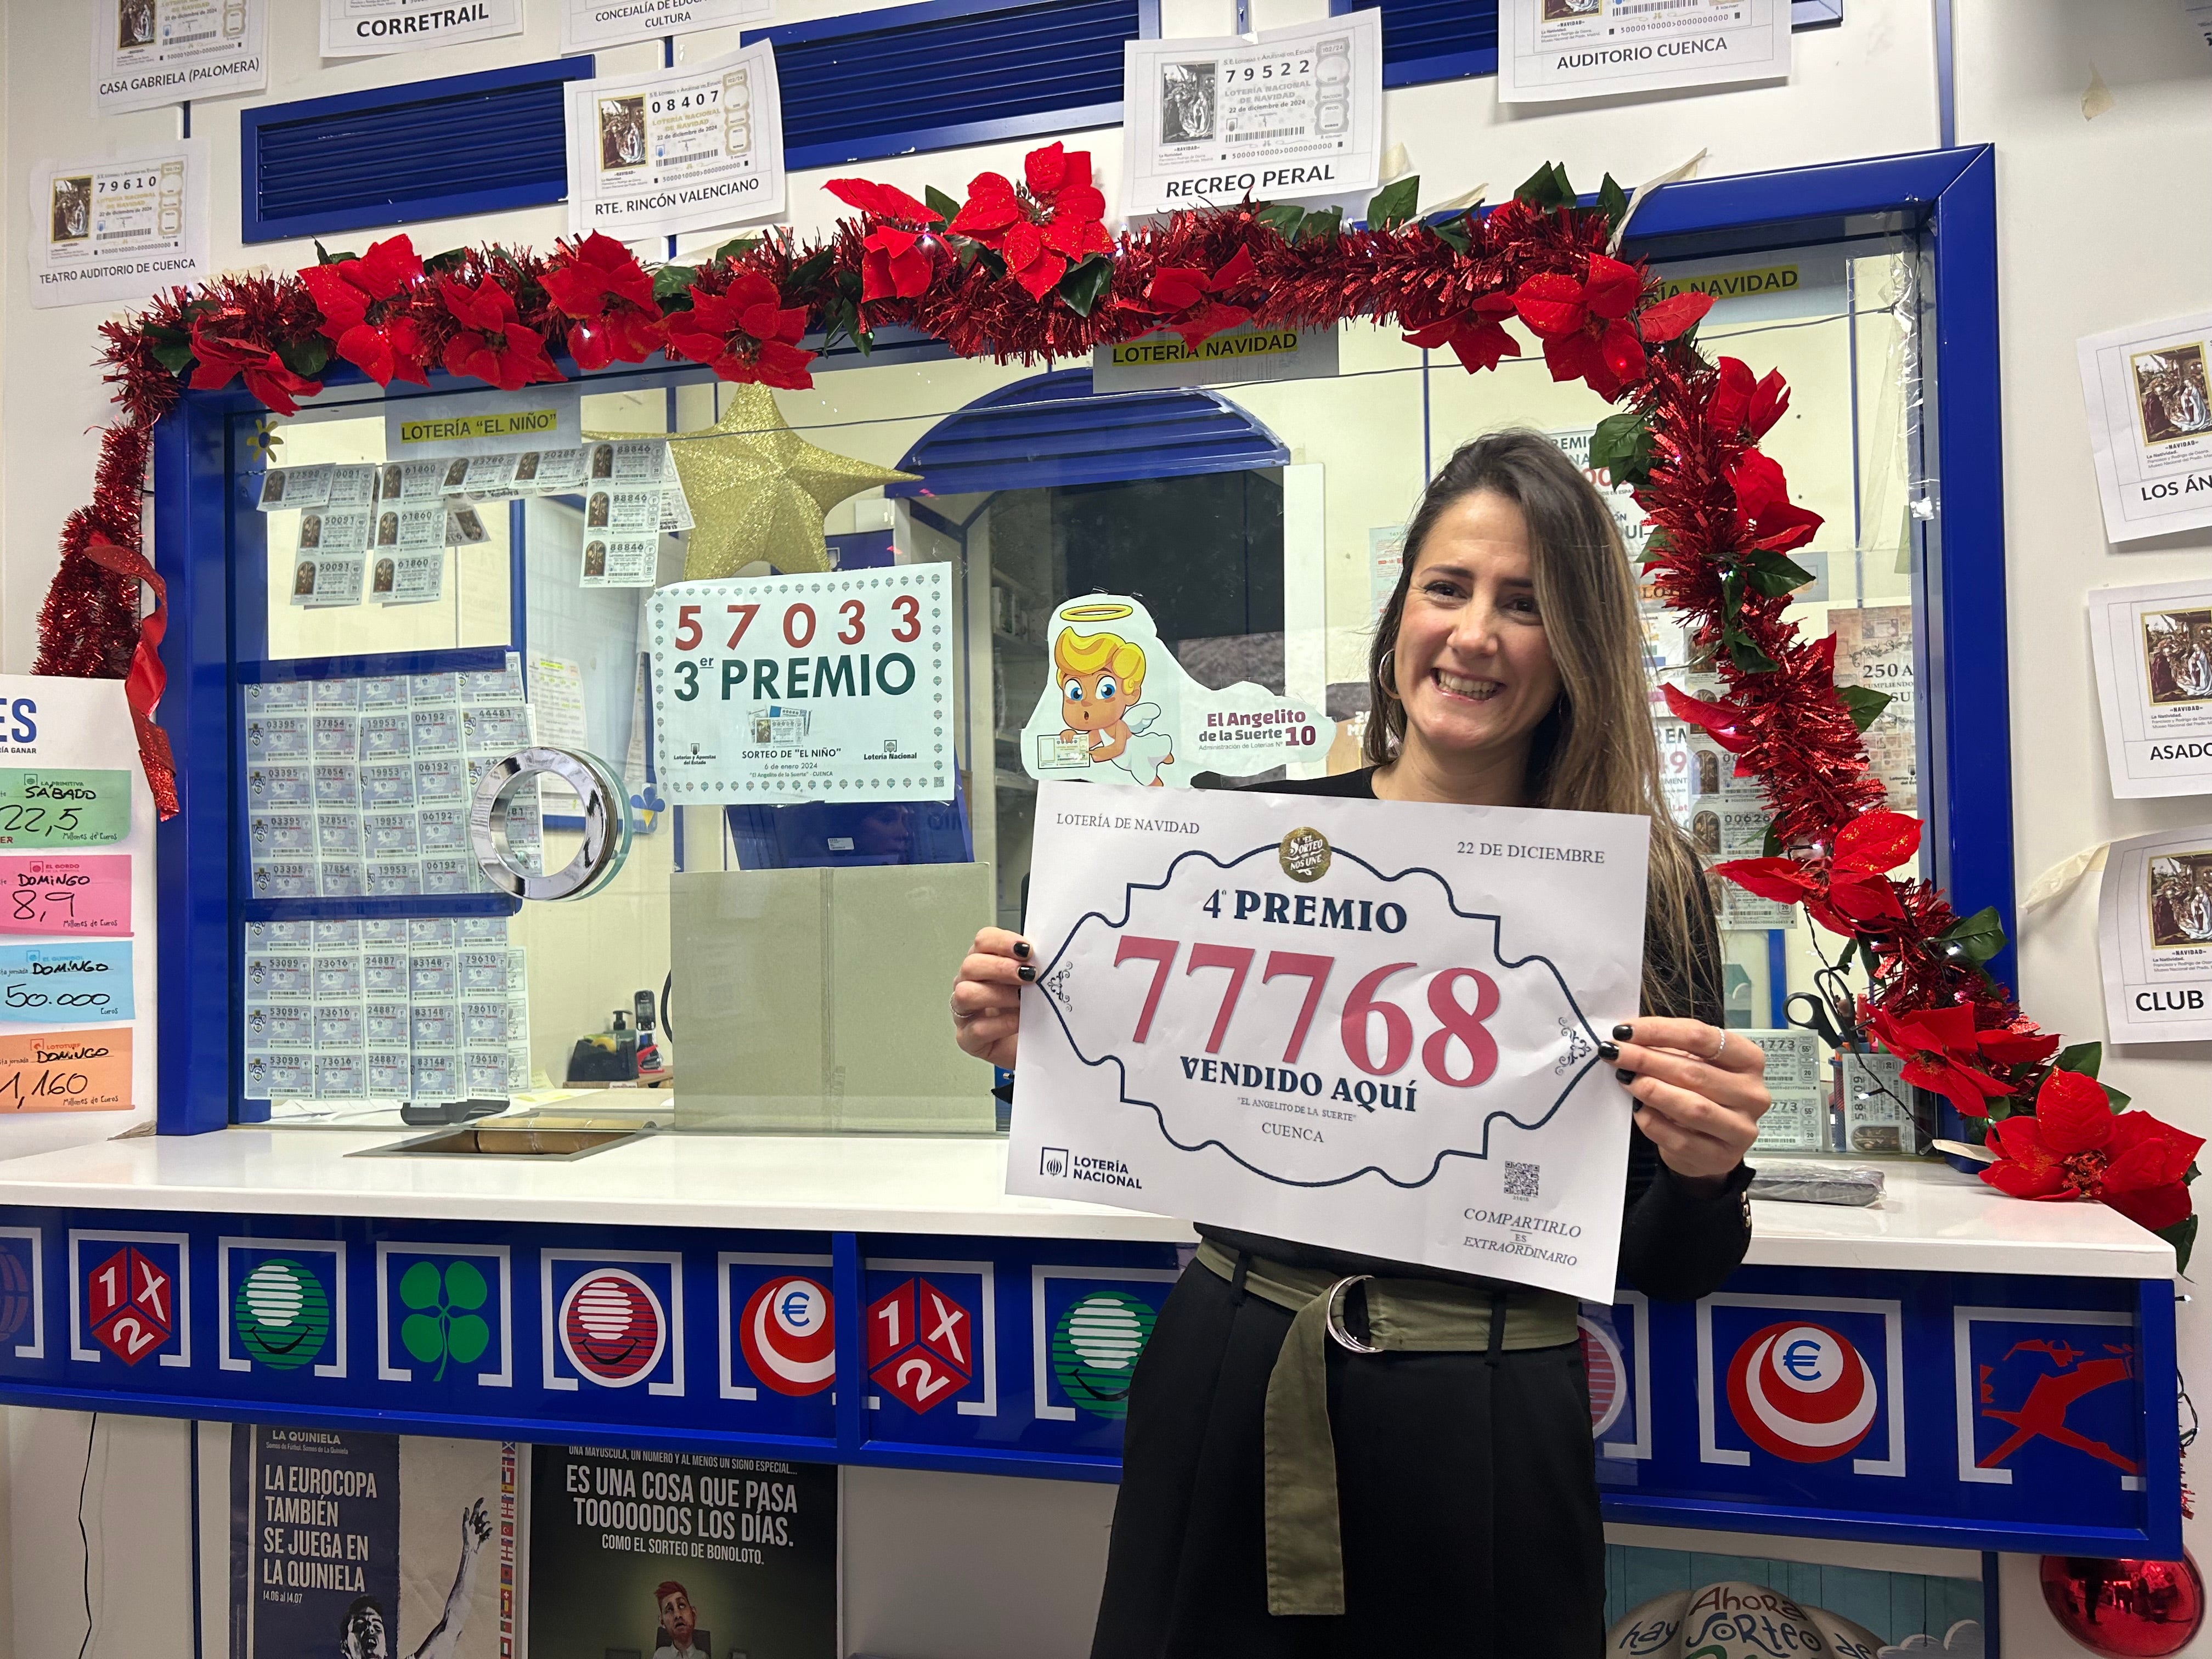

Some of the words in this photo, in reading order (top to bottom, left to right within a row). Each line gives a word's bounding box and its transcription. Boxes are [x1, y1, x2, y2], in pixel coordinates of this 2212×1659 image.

[356, 3, 489, 37] CORRETRAIL
[596, 2, 654, 22] CONCEJALÍA
[645, 12, 691, 27] CULTURA
[1557, 46, 1652, 70] AUDITORIO
[1657, 37, 1728, 57] CUENCA
[100, 81, 127, 94] CASA
[131, 72, 185, 89] GABRIELA
[189, 58, 259, 83] (PALOMERA)
[1226, 60, 1310, 83] 79522
[1225, 86, 1262, 97] LOTERÍA
[1265, 81, 1311, 93] NACIONAL
[1255, 91, 1295, 103] NAVIDAD
[652, 90, 719, 114] 08407
[1248, 103, 1279, 112] diciembre
[98, 176, 157, 193] 79610
[1166, 173, 1256, 198] RECREO
[1262, 165, 1335, 188] PERAL
[595, 202, 623, 215] RTE.
[627, 193, 676, 212] RINCÓN
[679, 178, 759, 204] VALENCIANO
[40, 270, 77, 284] TEATRO
[80, 264, 134, 280] AUDITORIO
[137, 262, 150, 273] DE
[153, 258, 196, 272] CUENCA
[1691, 270, 1798, 297] NAVIDAD
[1113, 341, 1199, 363] LOTERÍA
[1206, 332, 1297, 357] NAVIDAD
[402, 419, 471, 441] LOTERÍA
[617, 445, 651, 454] 88846
[405, 465, 436, 474] 61860
[2141, 482, 2179, 501] LOS
[2185, 474, 2212, 494] ÁN
[325, 516, 354, 524] 50091
[721, 653, 916, 701] PREMIO
[1863, 663, 1898, 679] 250
[316, 719, 345, 727] 37854
[367, 719, 396, 727] 19953
[415, 713, 445, 723] 06192
[479, 709, 511, 718] 44481
[1207, 712, 1223, 727] El
[1227, 708, 1306, 728] Angelito
[267, 720, 295, 729] 03395
[1199, 731, 1217, 742] de
[1219, 730, 1232, 741] la
[1235, 728, 1283, 741] Suerte
[1285, 725, 1316, 747] 10
[742, 749, 777, 759] SORTEO
[781, 749, 792, 758] DE
[864, 752, 888, 760] Lotería
[889, 752, 917, 760] Nacional
[1199, 743, 1241, 751] Administración
[1057, 813, 1111, 828] LOTERÍA
[1114, 817, 1131, 830] DE
[1135, 819, 1200, 834] NAVIDAD
[1290, 859, 1305, 871] NOS
[1306, 854, 1323, 866] UNE
[1457, 841, 1475, 854] 22
[1480, 843, 1502, 856] DE
[1507, 844, 1605, 864] DICIEMBRE
[12, 889, 75, 922] 8,9
[1234, 890, 1408, 934] PREMIO
[63, 920, 88, 928] Millones
[100, 919, 118, 927] Euros
[365, 956, 394, 964] 24887
[413, 958, 442, 967] 83148
[465, 955, 496, 963] 79610
[5, 984, 110, 1007] 50.000
[2135, 990, 2204, 1011] CLUB
[1113, 935, 1501, 1090] 77768
[1752, 1040, 1796, 1049] 1773
[1180, 1056, 1323, 1097] VENDIDO
[1331, 1077, 1418, 1114] AQUÍ
[1252, 1099, 1294, 1113] ANGELITO
[1294, 1105, 1306, 1114] DE
[1307, 1107, 1319, 1116] LA
[1262, 1122, 1324, 1143] CUENCA
[1074, 1155, 1128, 1174] LOTERÍA
[1074, 1169, 1142, 1189] NACIONAL
[1464, 1208, 1581, 1238] COMPARTIRLO
[1515, 1233, 1527, 1243] ES
[1463, 1236, 1577, 1266] EXTRAORDINARIO
[272, 1430, 286, 1441] LA
[289, 1431, 341, 1444] QUINIELA
[631, 1450, 641, 1461] UN
[675, 1454, 680, 1464] Y
[681, 1454, 691, 1465] AL
[692, 1455, 719, 1468] MENOS
[719, 1458, 730, 1469] UN
[731, 1458, 754, 1471] SIGNO
[265, 1464, 284, 1491] LA
[289, 1466, 377, 1499] EUROCOPA
[566, 1464, 590, 1494] ES
[596, 1466, 636, 1498] UNA
[642, 1471, 695, 1504] COSA
[700, 1476, 740, 1509] QUE
[746, 1480, 798, 1514] PASA
[265, 1494, 338, 1528] TAMBIÉN
[573, 1497, 692, 1536] TOOOOODOS
[698, 1508, 735, 1541] LOS
[741, 1505, 794, 1547] DÍAS.
[263, 1527, 284, 1554] SE
[288, 1530, 343, 1559] JUEGA
[347, 1534, 369, 1561] EN
[602, 1533, 631, 1551] COMO
[634, 1537, 646, 1553] EL
[648, 1538, 689, 1556] SORTEO
[691, 1542, 704, 1559] DE
[707, 1543, 765, 1565] BONOLOTO.
[263, 1558, 283, 1585] LA
[287, 1560, 365, 1593] QUINIELA
[280, 1591, 285, 1602] al
[1619, 1619, 1681, 1656] hay
